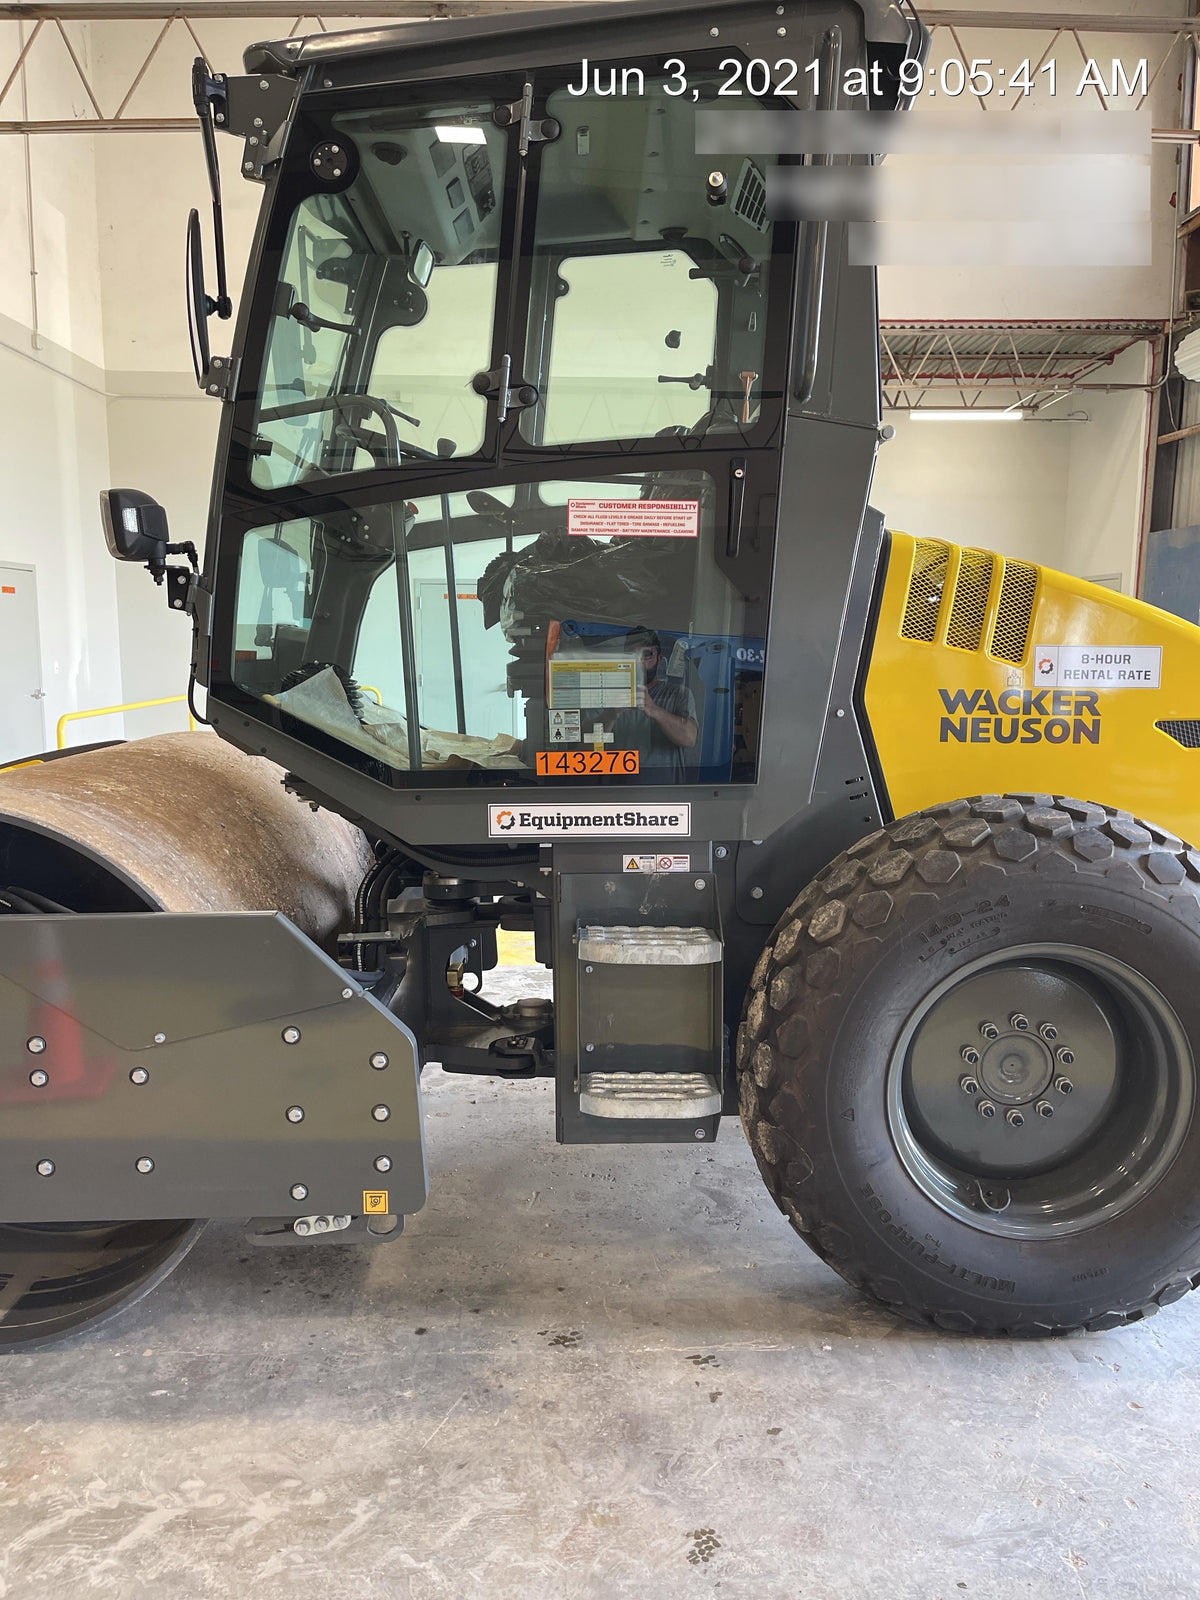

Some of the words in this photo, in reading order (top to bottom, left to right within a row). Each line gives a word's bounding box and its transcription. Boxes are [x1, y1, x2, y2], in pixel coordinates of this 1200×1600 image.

[1081, 653, 1132, 665] 8-HOUR
[1063, 669, 1114, 681] RENTAL
[1117, 669, 1152, 681] RATE
[938, 688, 1102, 717] WACKER
[939, 717, 1101, 745] NEUSON
[539, 751, 637, 775] 143276
[519, 812, 680, 831] EquipmentShare
